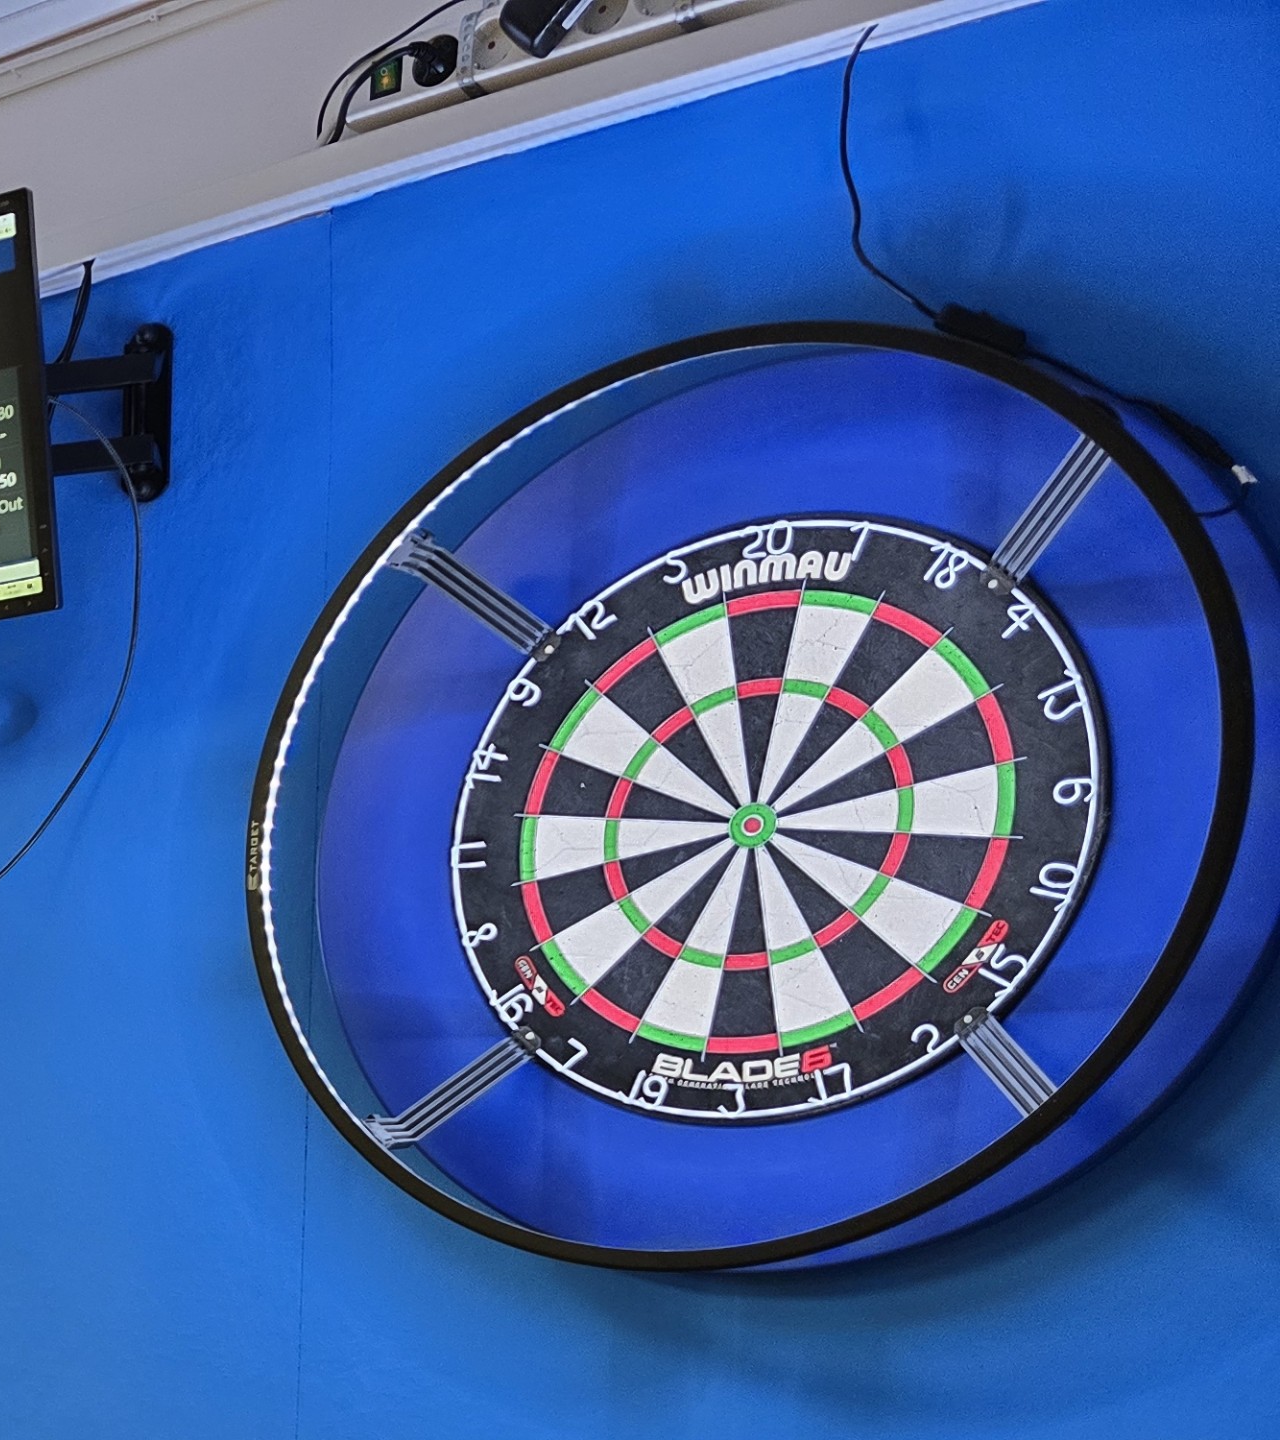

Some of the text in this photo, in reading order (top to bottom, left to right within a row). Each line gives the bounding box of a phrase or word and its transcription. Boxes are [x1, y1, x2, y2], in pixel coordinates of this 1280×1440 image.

[742, 520, 792, 559] 20
[850, 520, 870, 562] 1
[663, 551, 688, 584] 5
[681, 550, 853, 604] WINMAU
[924, 543, 969, 589] 18
[564, 599, 618, 640] 12
[1001, 602, 1036, 639] 4
[509, 677, 541, 707] 9
[1038, 669, 1084, 721] 13
[466, 743, 508, 789] 14
[1052, 777, 1096, 805] 6
[451, 840, 487, 868] 11
[1029, 862, 1080, 911] 10
[462, 922, 498, 948] 8
[947, 968, 970, 991] GEN
[985, 921, 1006, 943] TEC
[978, 944, 1030, 998] 15
[490, 983, 534, 1023] 16
[557, 1037, 588, 1072] 7
[911, 1023, 941, 1053] 2
[617, 1069, 669, 1109] 19
[717, 1083, 745, 1117] 3
[808, 1062, 852, 1104] 17
